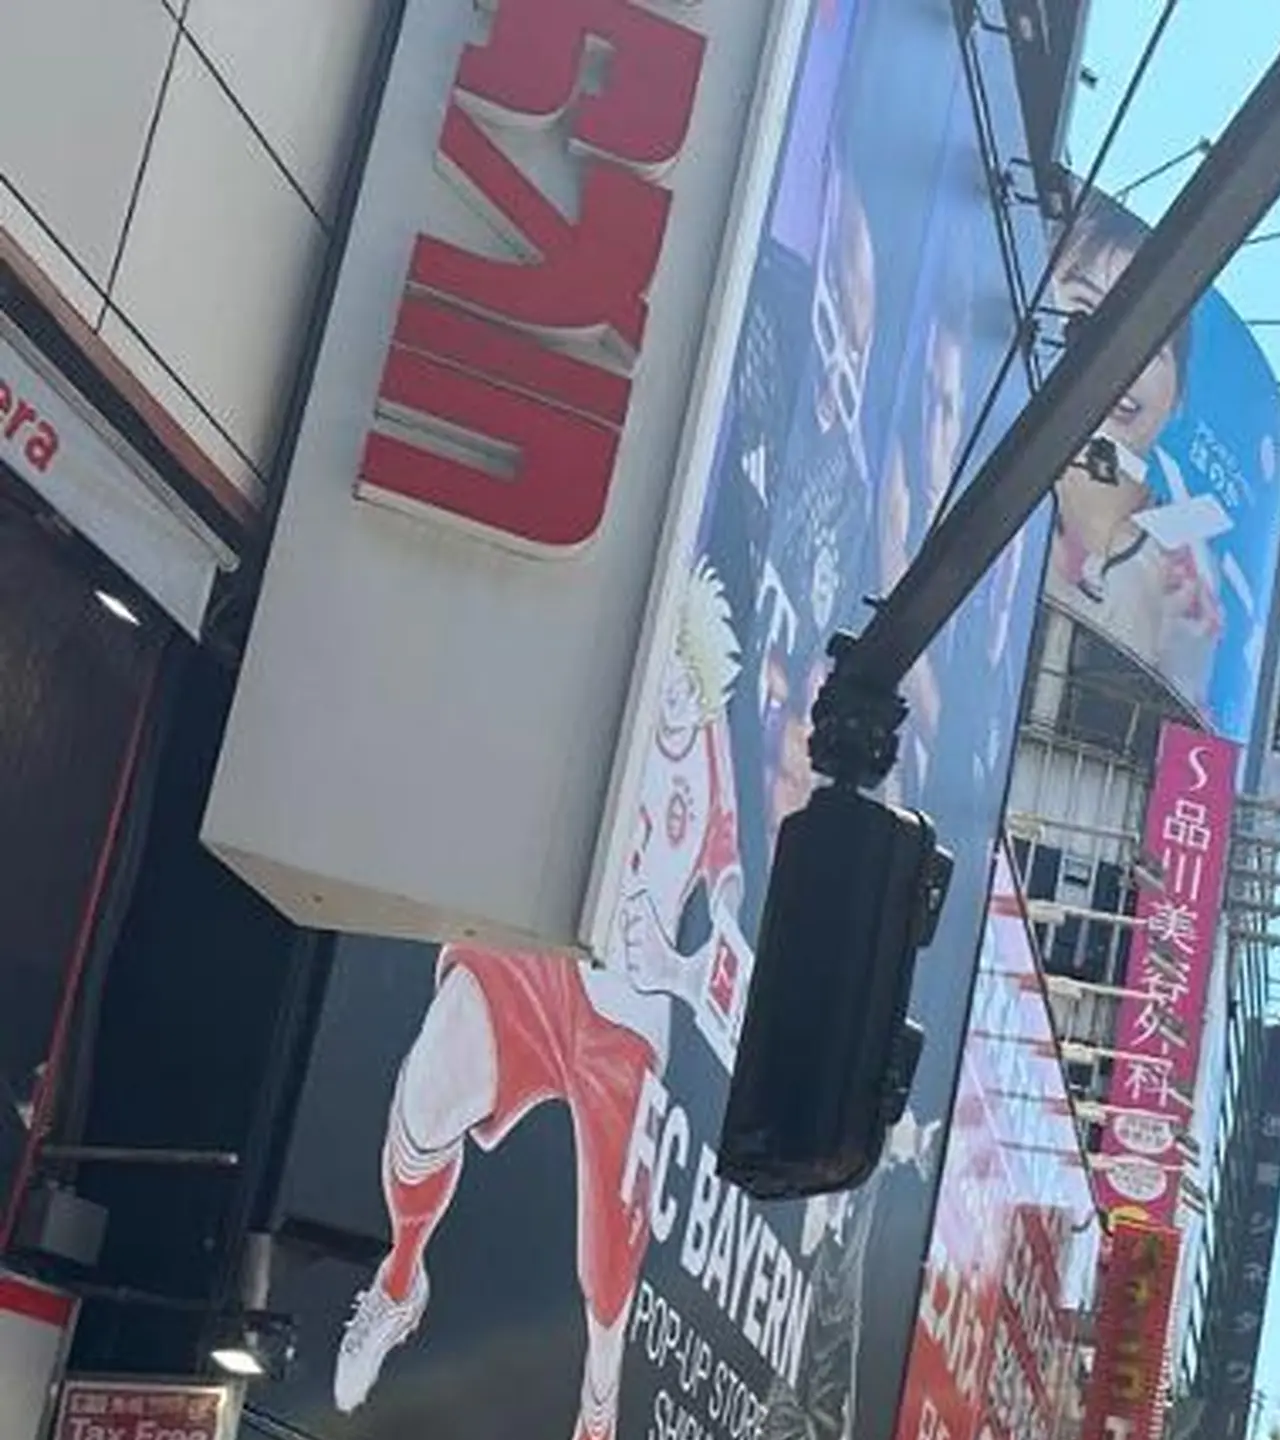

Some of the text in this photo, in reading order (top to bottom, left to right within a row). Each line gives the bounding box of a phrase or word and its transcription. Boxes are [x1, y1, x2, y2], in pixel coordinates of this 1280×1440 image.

[620, 1075, 813, 1389] FC BAYERN
[630, 1280, 713, 1400] POP-UP
